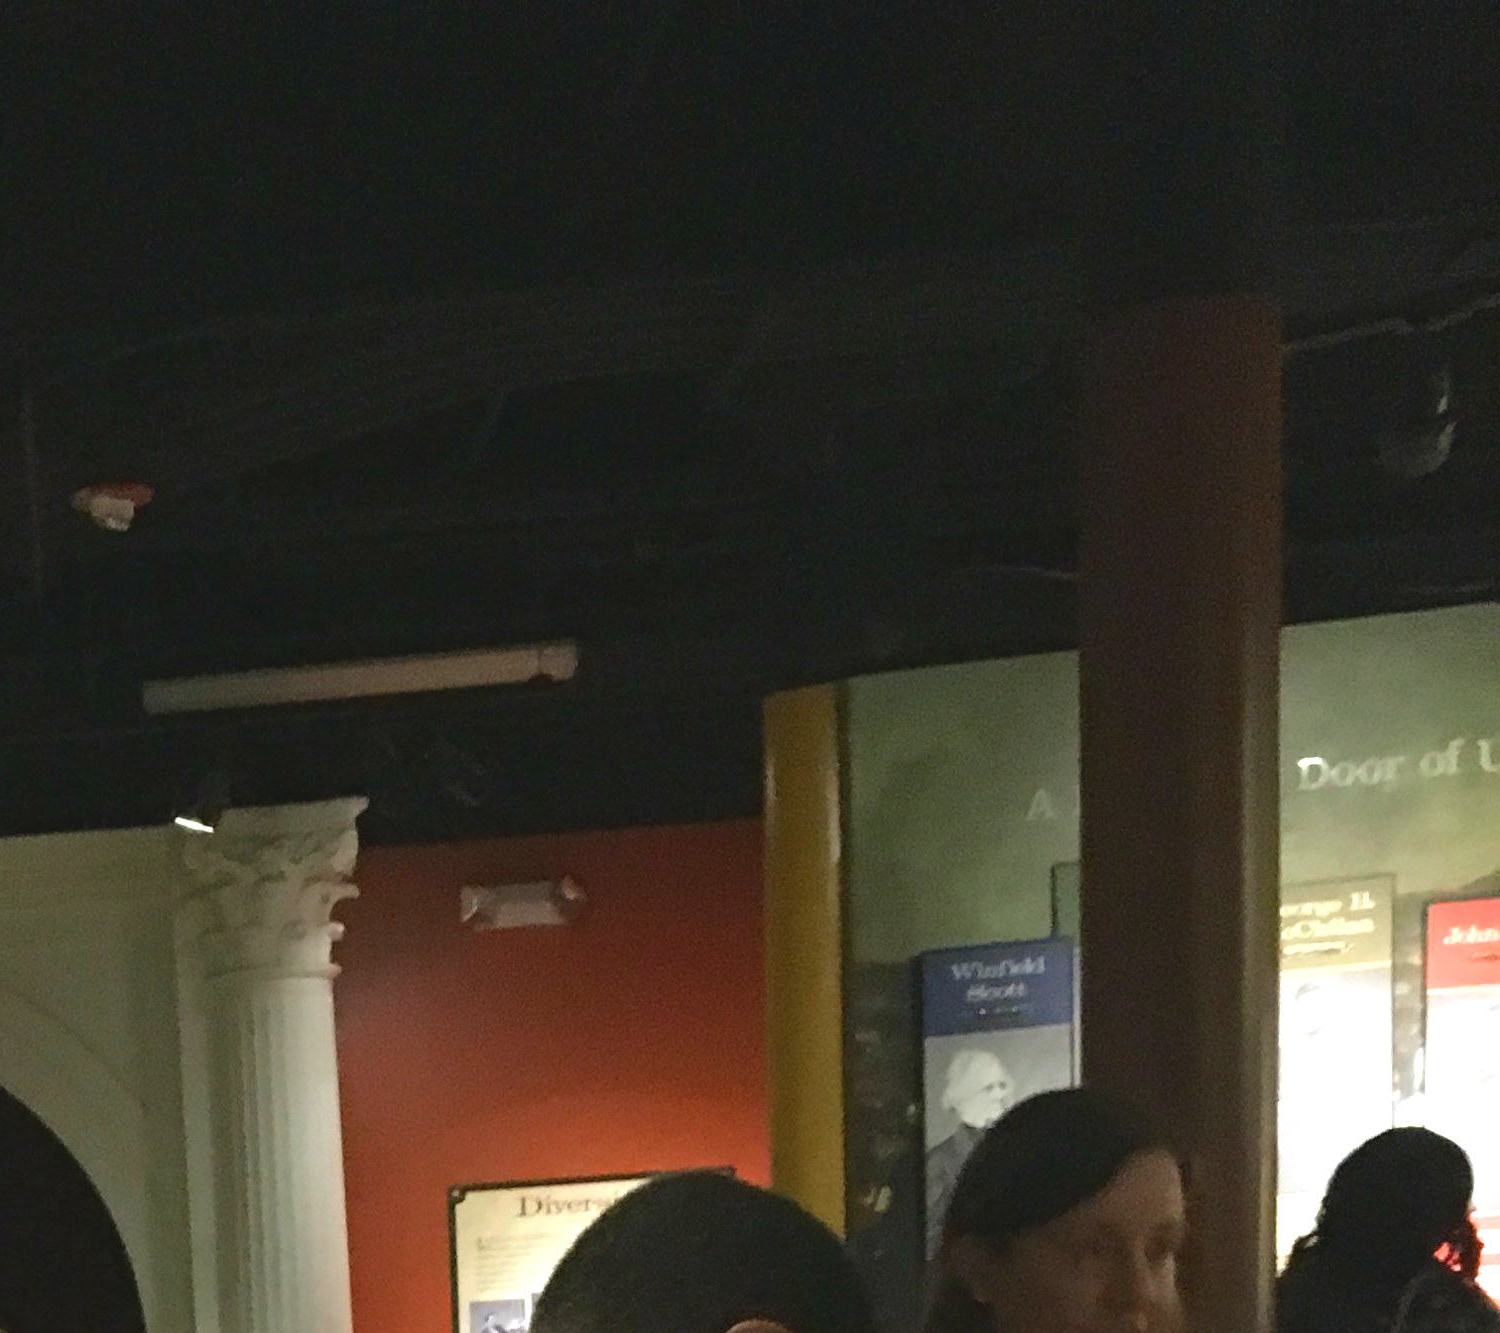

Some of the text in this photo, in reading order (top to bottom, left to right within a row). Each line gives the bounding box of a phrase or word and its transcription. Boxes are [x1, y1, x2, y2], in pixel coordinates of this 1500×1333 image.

[1297, 756, 1406, 791] Door
[1420, 738, 1465, 777] of
[950, 955, 1046, 980] Winfield
